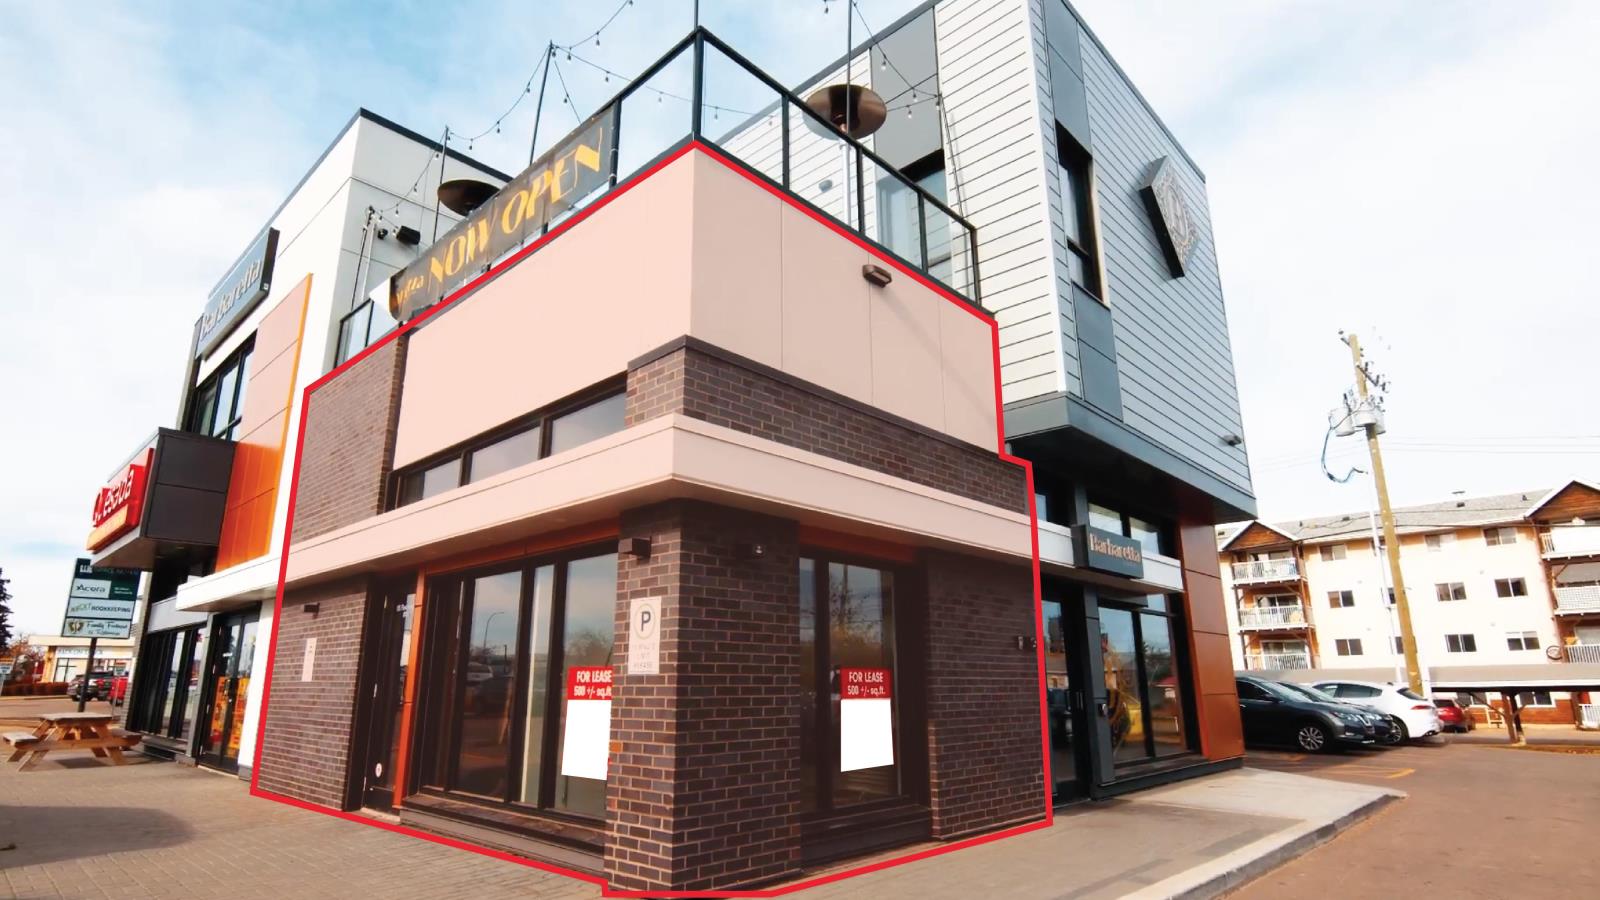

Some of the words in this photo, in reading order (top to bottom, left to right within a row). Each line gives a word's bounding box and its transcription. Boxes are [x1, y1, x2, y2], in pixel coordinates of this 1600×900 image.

[428, 202, 498, 293] NOW
[502, 127, 603, 235] OPEN
[640, 610, 651, 632] P
[576, 670, 590, 683] FOR
[592, 670, 612, 683] LEASE
[848, 671, 863, 683] FOR
[864, 671, 884, 683] LEASE
[573, 685, 586, 696] 500
[847, 685, 859, 695] 500
